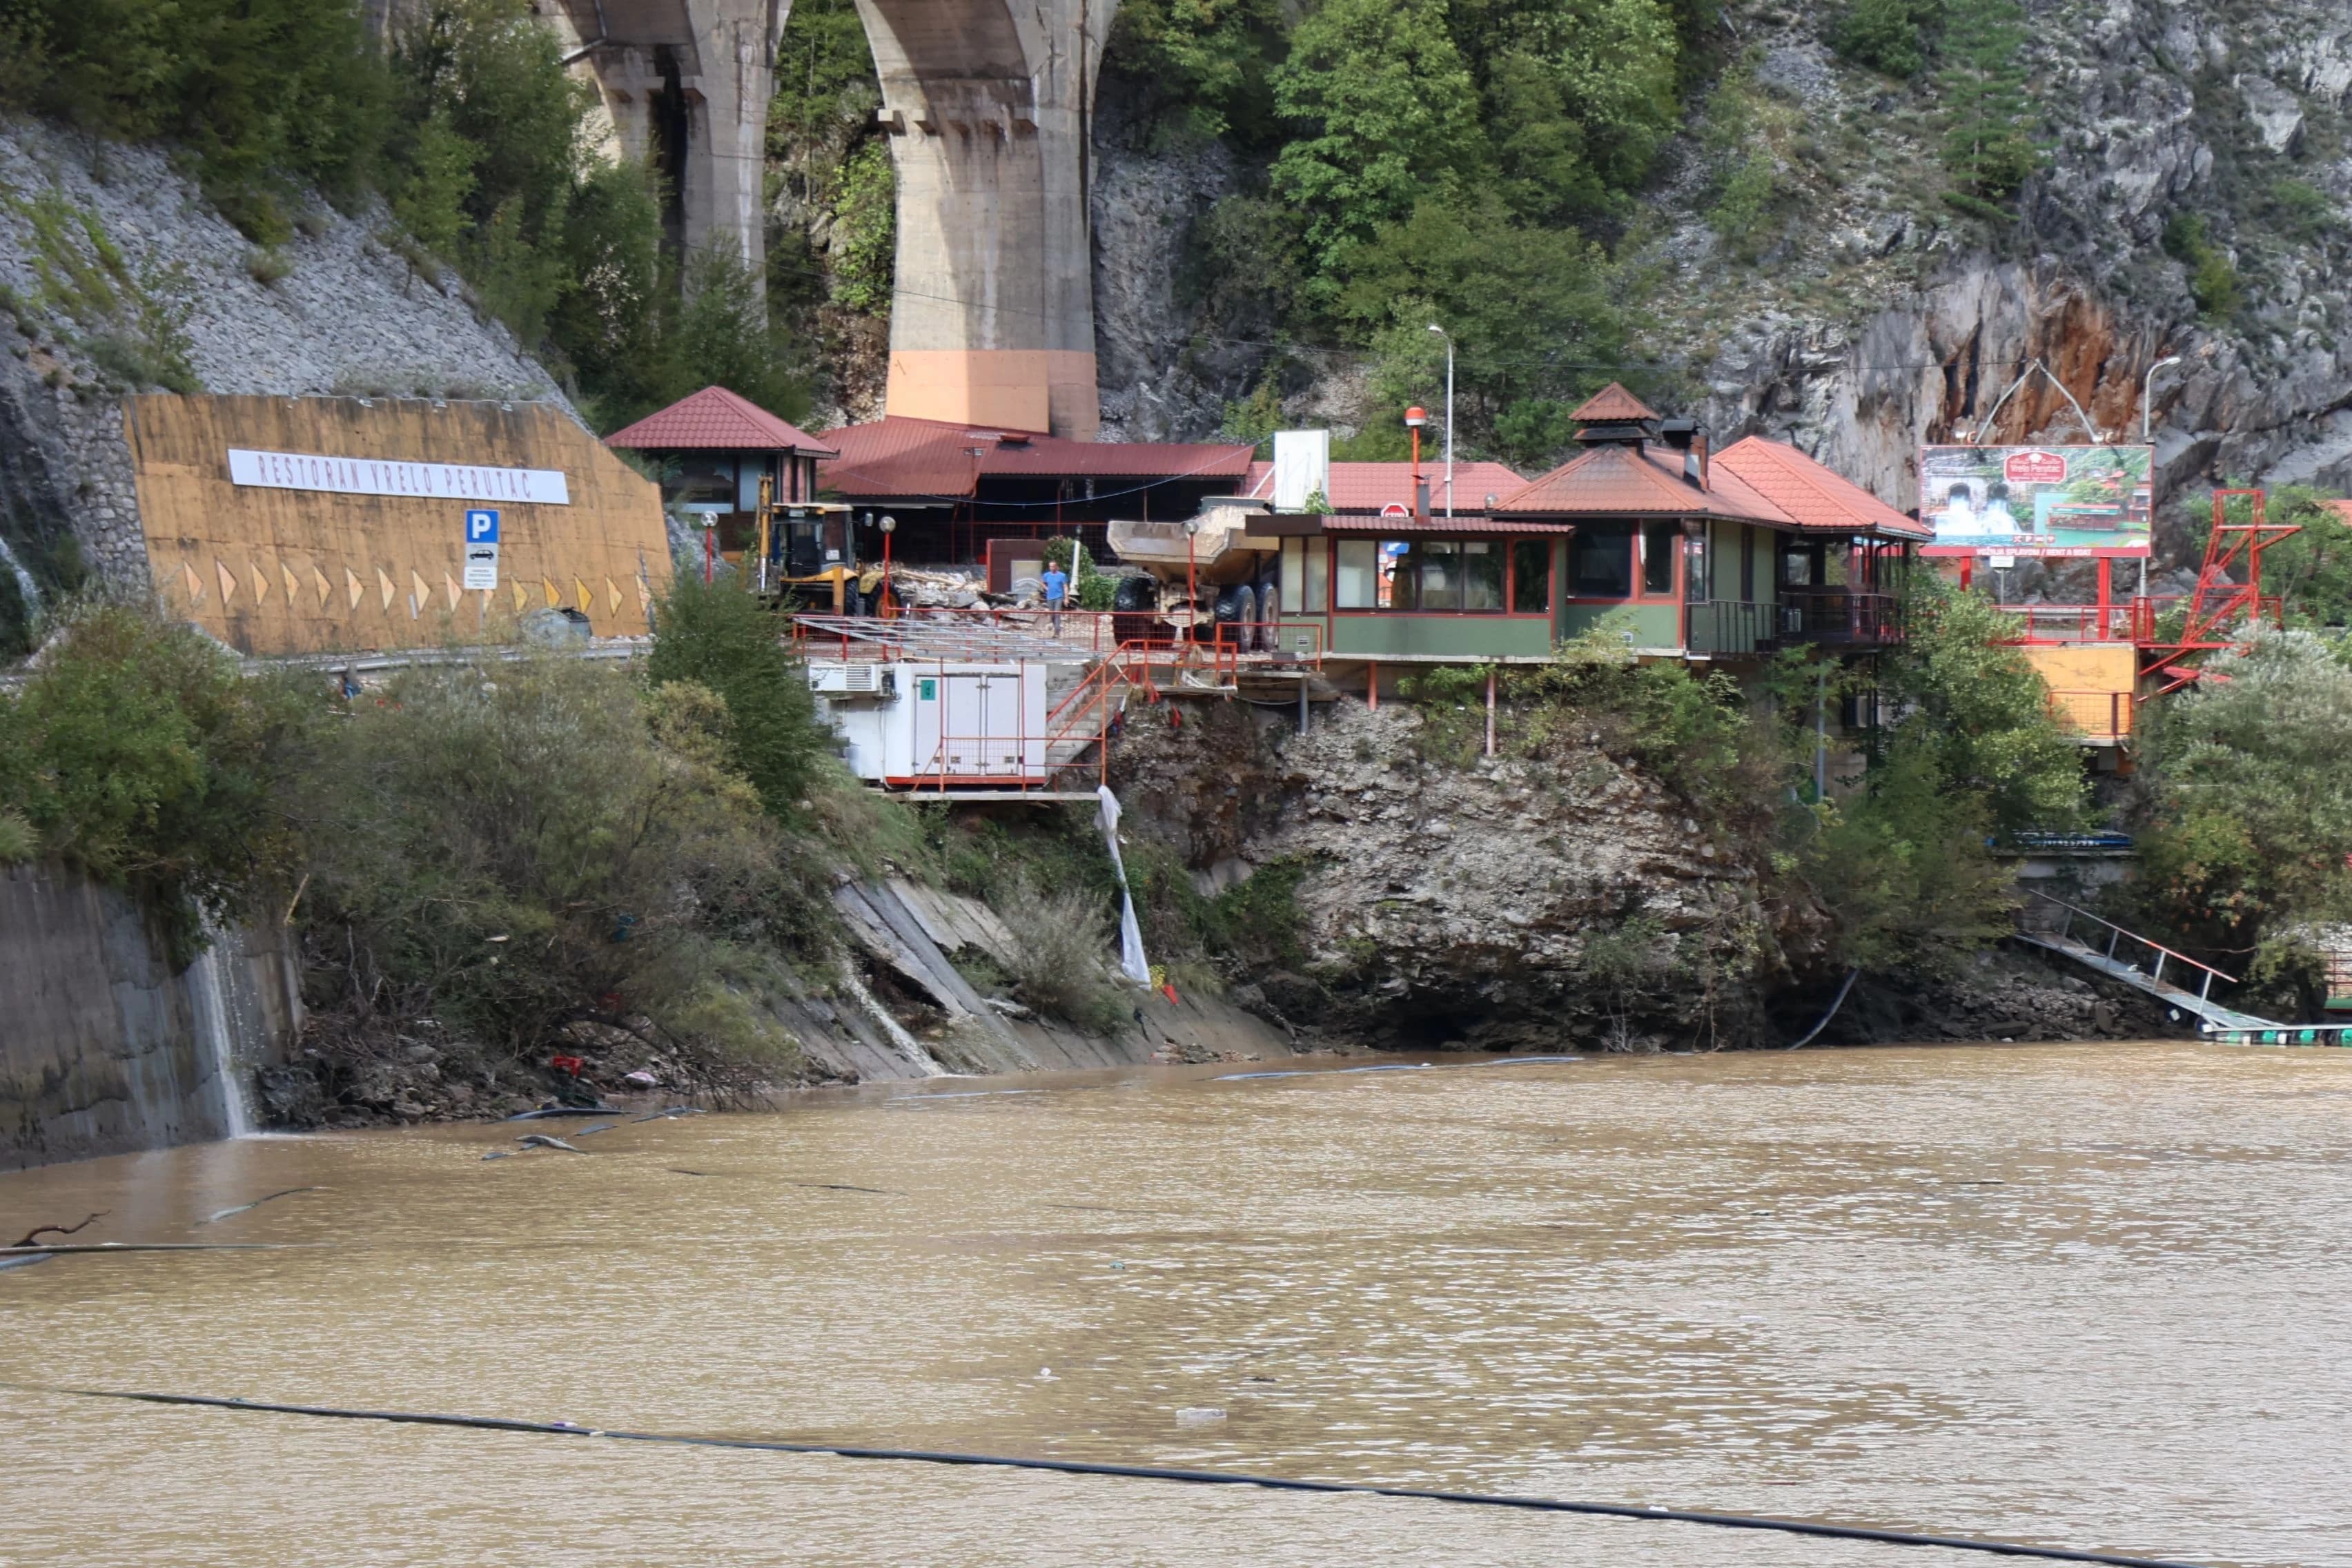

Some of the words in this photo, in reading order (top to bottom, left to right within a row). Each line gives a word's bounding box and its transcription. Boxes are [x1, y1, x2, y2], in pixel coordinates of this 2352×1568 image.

[258, 455, 360, 489] RESTORAN
[371, 463, 432, 494] VRELO
[444, 467, 531, 499] PERUTAC
[472, 513, 491, 539] P
